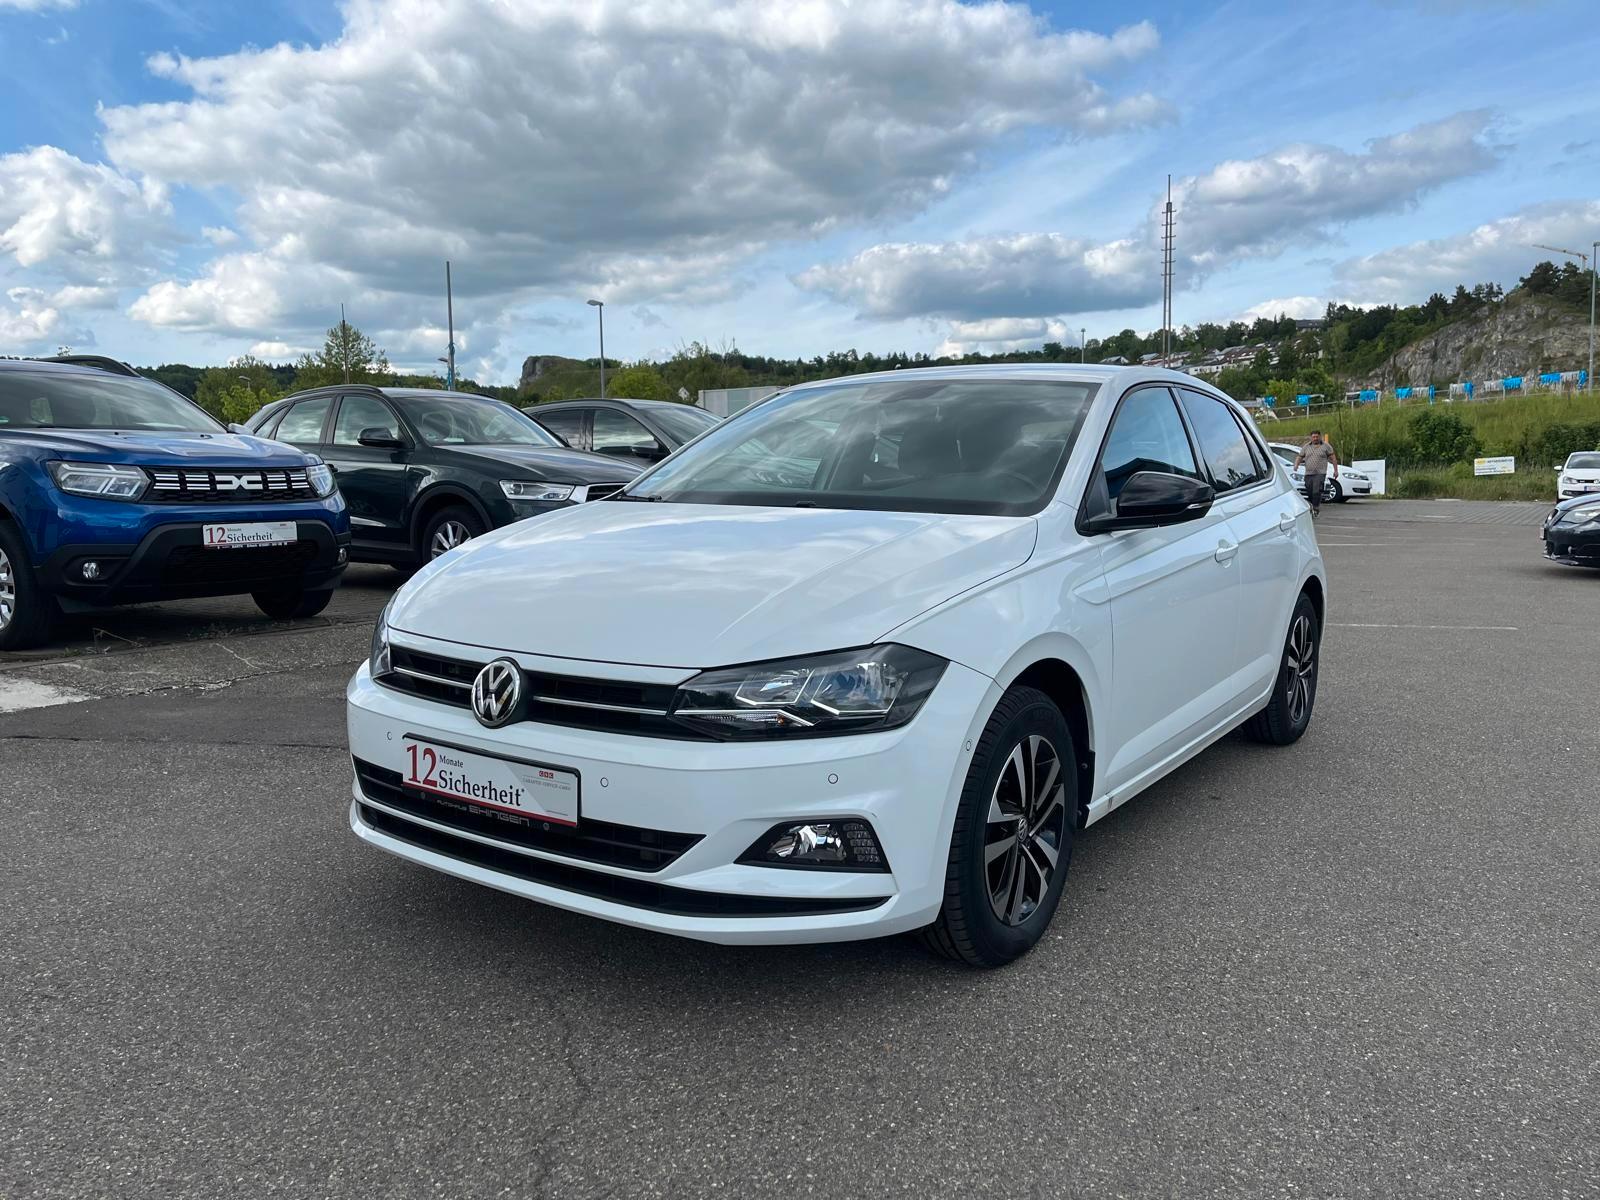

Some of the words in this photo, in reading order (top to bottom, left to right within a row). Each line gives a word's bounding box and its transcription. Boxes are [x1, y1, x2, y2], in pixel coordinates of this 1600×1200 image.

[206, 527, 227, 543] 12
[227, 532, 273, 542] Sicherheit
[406, 744, 438, 788] 12
[439, 754, 464, 768] Monate
